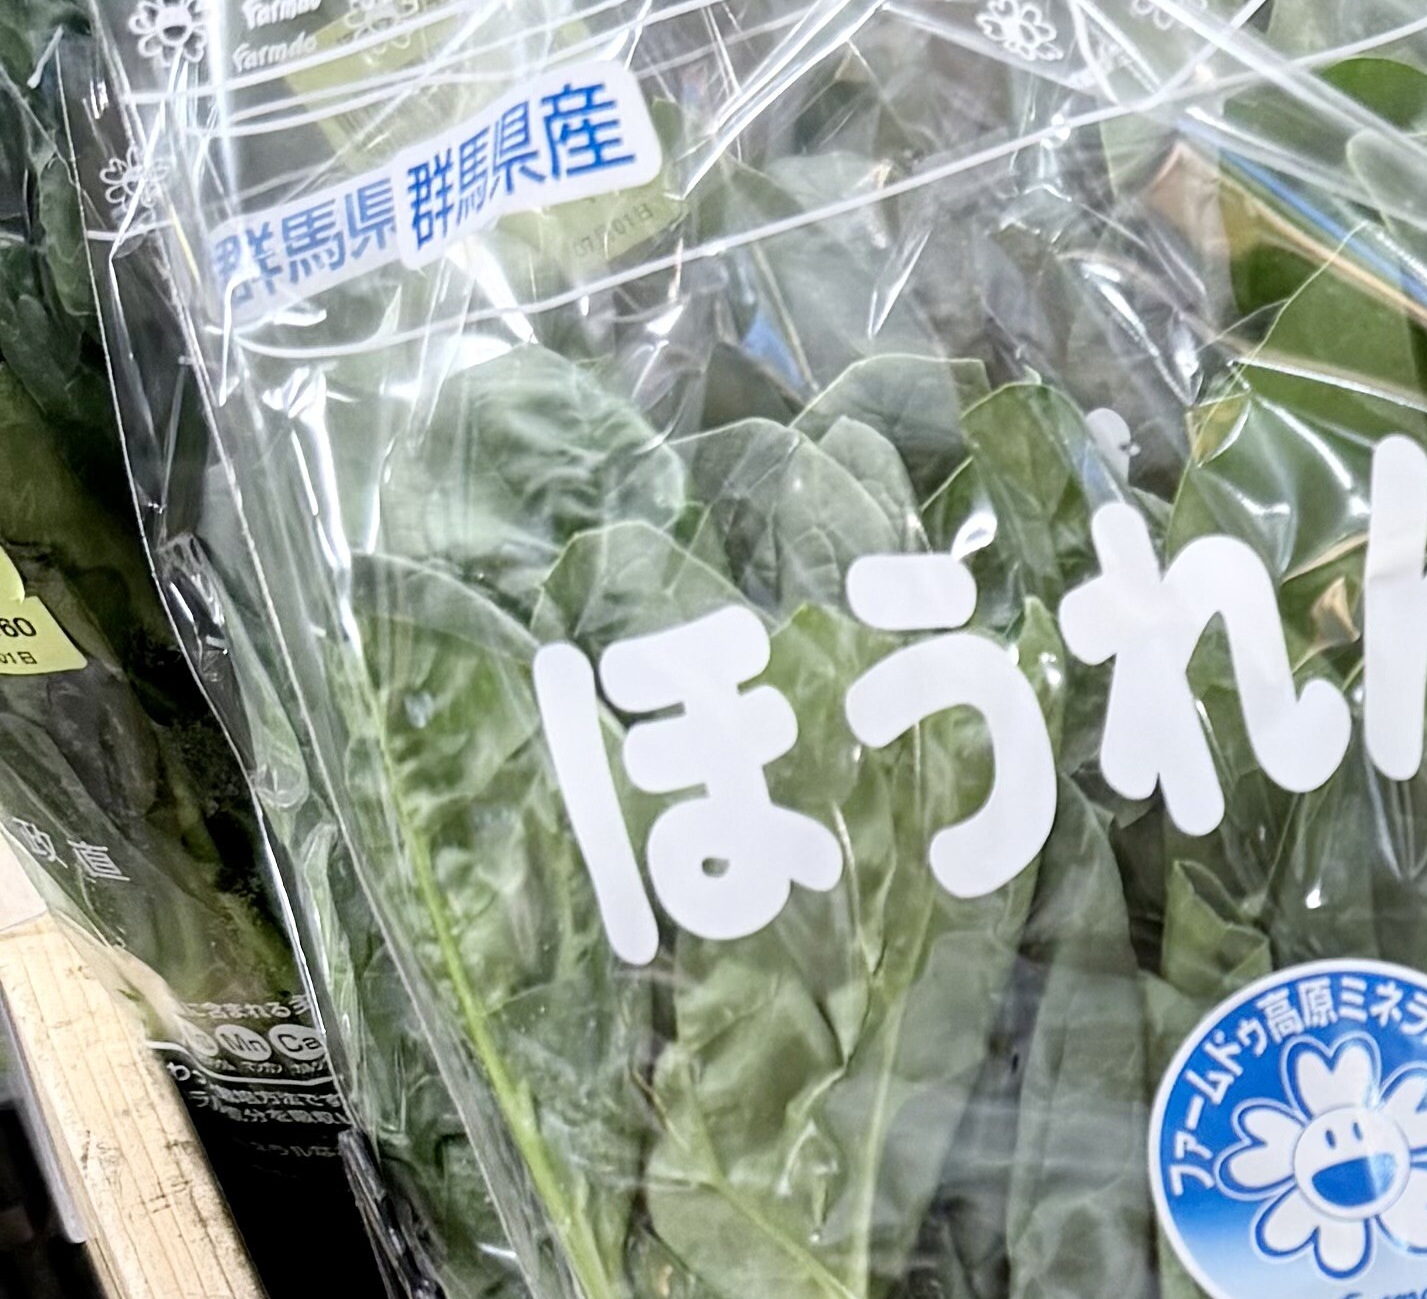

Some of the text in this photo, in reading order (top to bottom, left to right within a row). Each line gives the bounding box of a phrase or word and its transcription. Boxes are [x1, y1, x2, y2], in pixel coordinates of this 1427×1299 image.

[233, 33, 318, 71] Farmdo
[407, 80, 638, 250] 群馬県産
[211, 174, 400, 303] 群馬県
